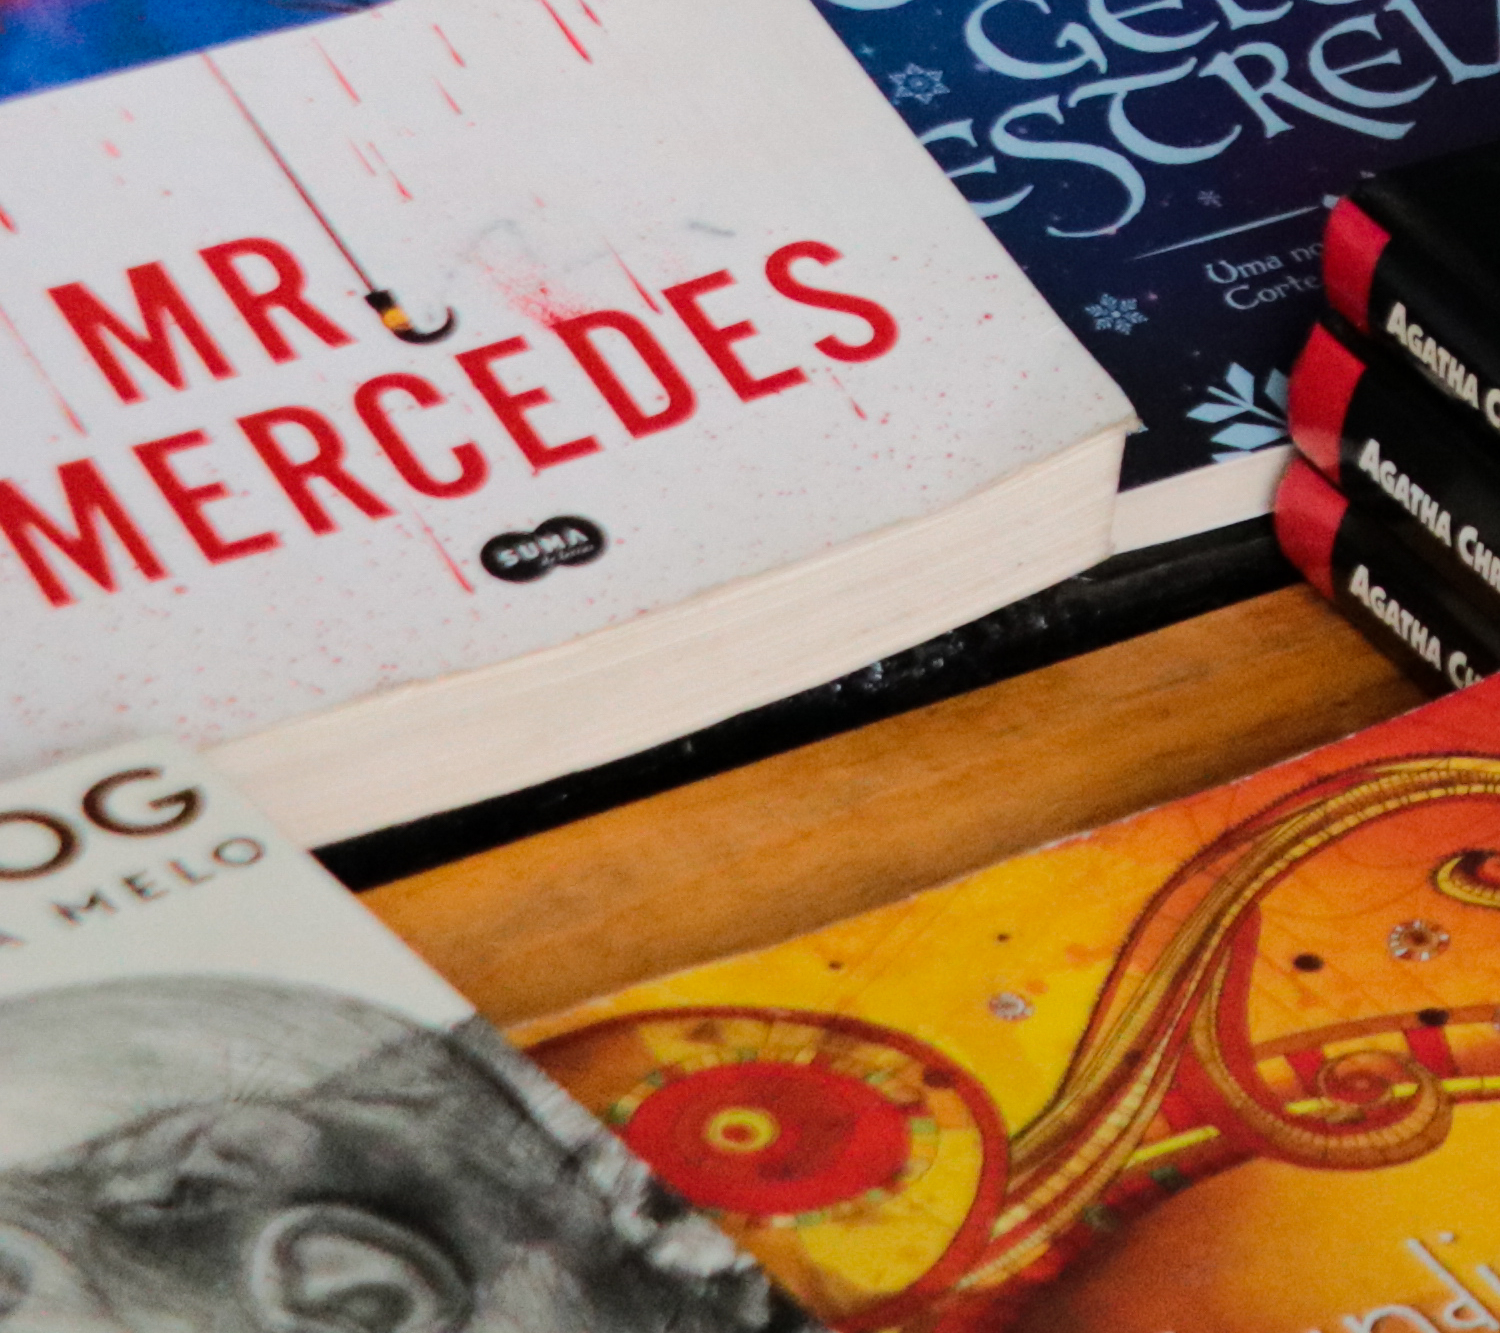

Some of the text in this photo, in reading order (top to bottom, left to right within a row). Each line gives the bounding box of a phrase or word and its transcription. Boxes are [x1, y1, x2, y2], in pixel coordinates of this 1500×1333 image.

[1205, 252, 1284, 287] Uma
[1224, 273, 1323, 311] Corte
[1385, 301, 1481, 411] AGATHA
[0, 238, 899, 609] MERCEDES
[1358, 438, 1453, 549] AGATHA
[497, 528, 590, 568] SUMA
[1348, 563, 1443, 672] AGATHA
[51, 836, 266, 927] MELO
